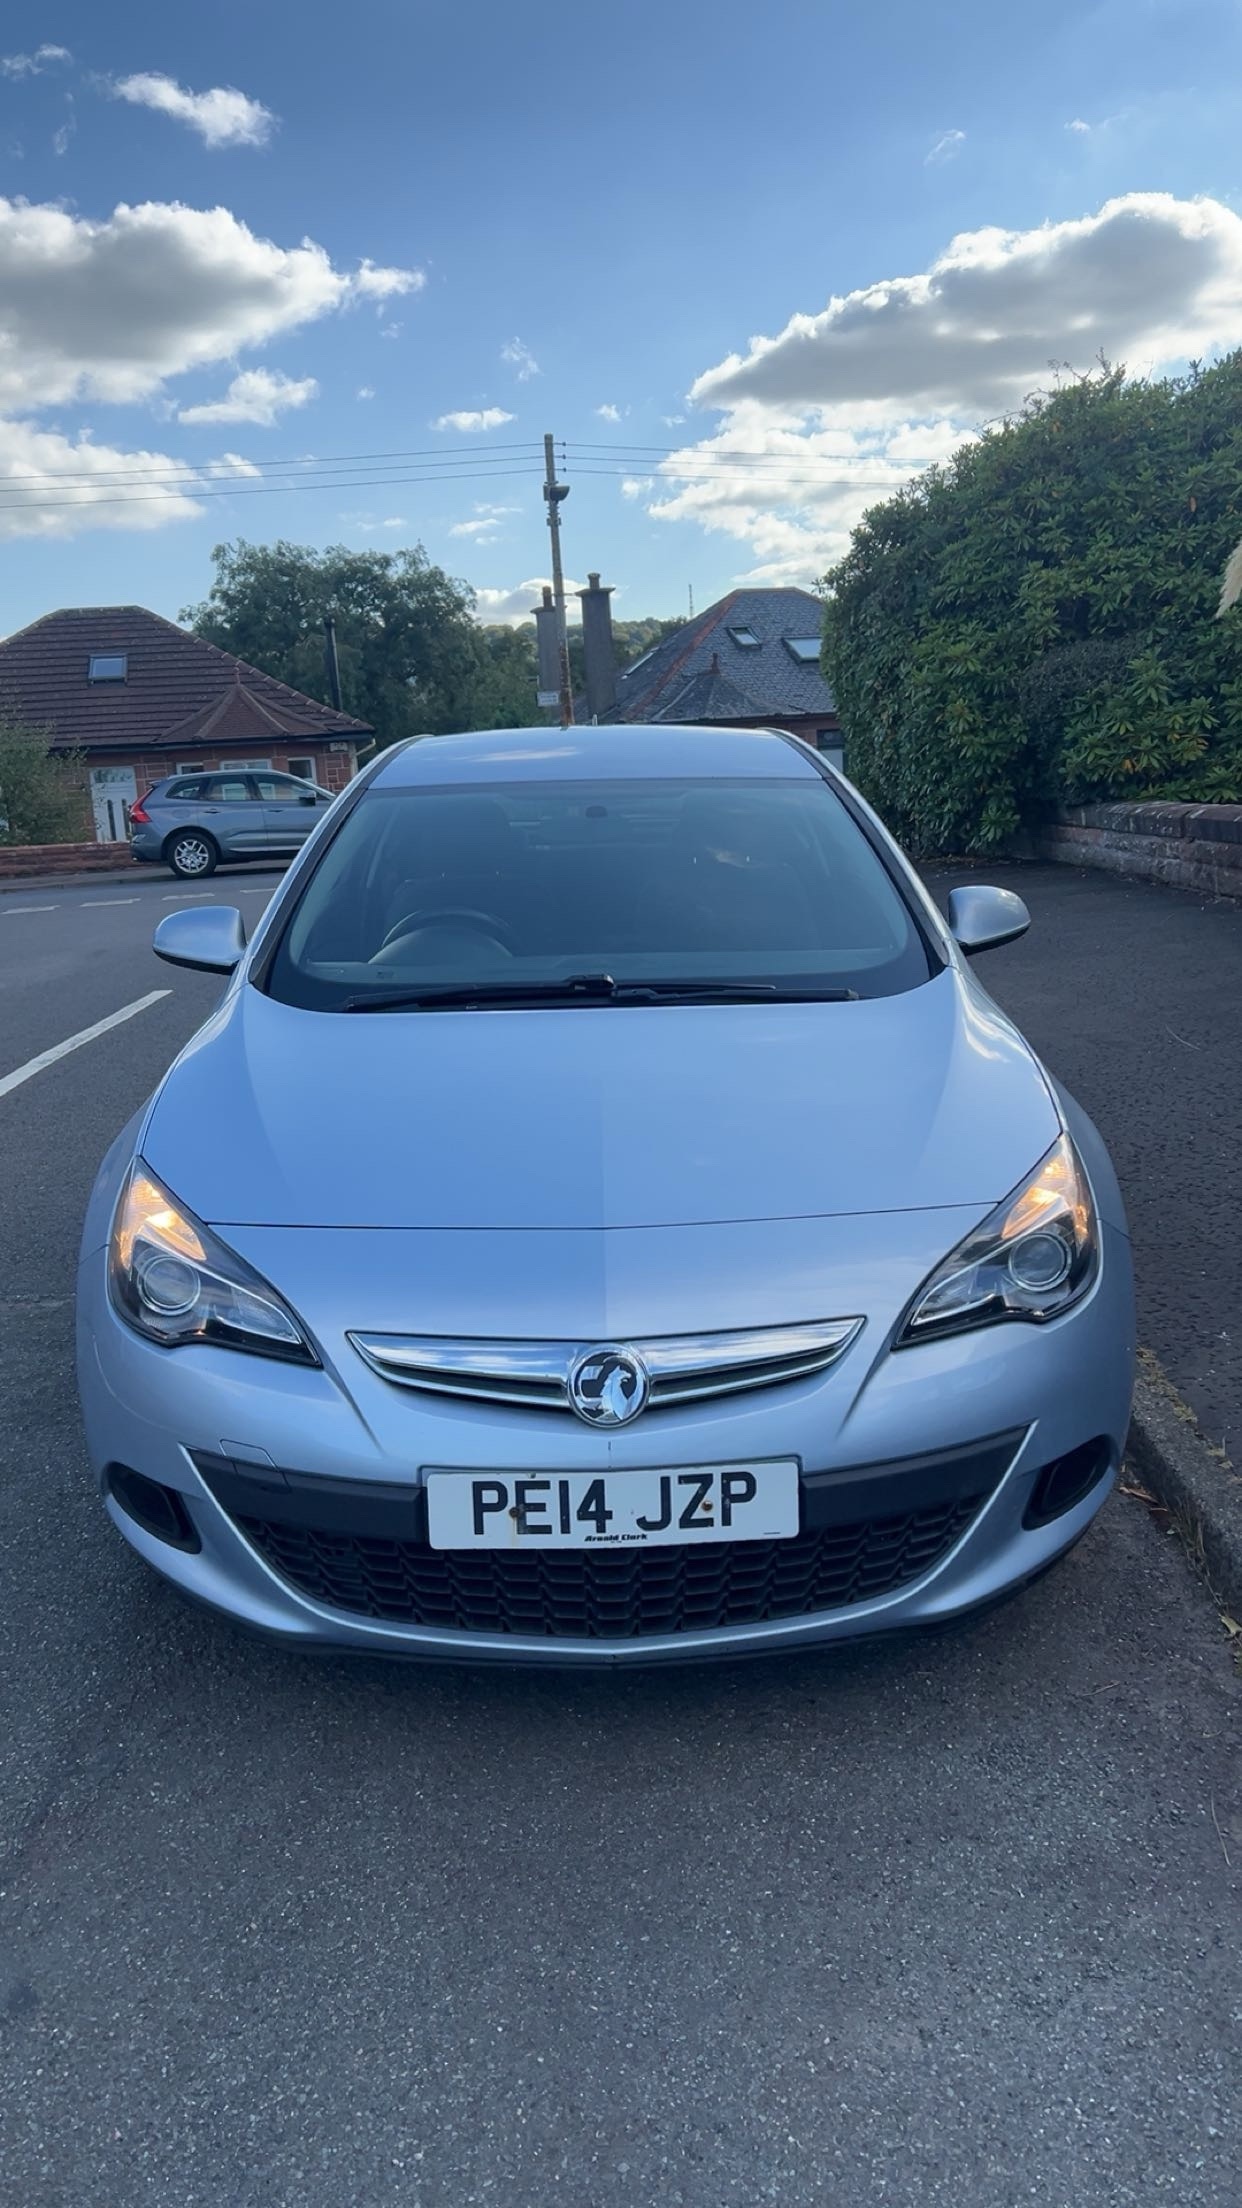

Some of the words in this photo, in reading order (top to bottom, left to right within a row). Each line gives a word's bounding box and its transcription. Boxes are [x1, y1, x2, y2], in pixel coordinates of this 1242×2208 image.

[472, 1479, 613, 1535] PE14
[636, 1471, 757, 1532] JZP
[584, 1534, 620, 1542] Arnold
[621, 1533, 648, 1541] Clark
